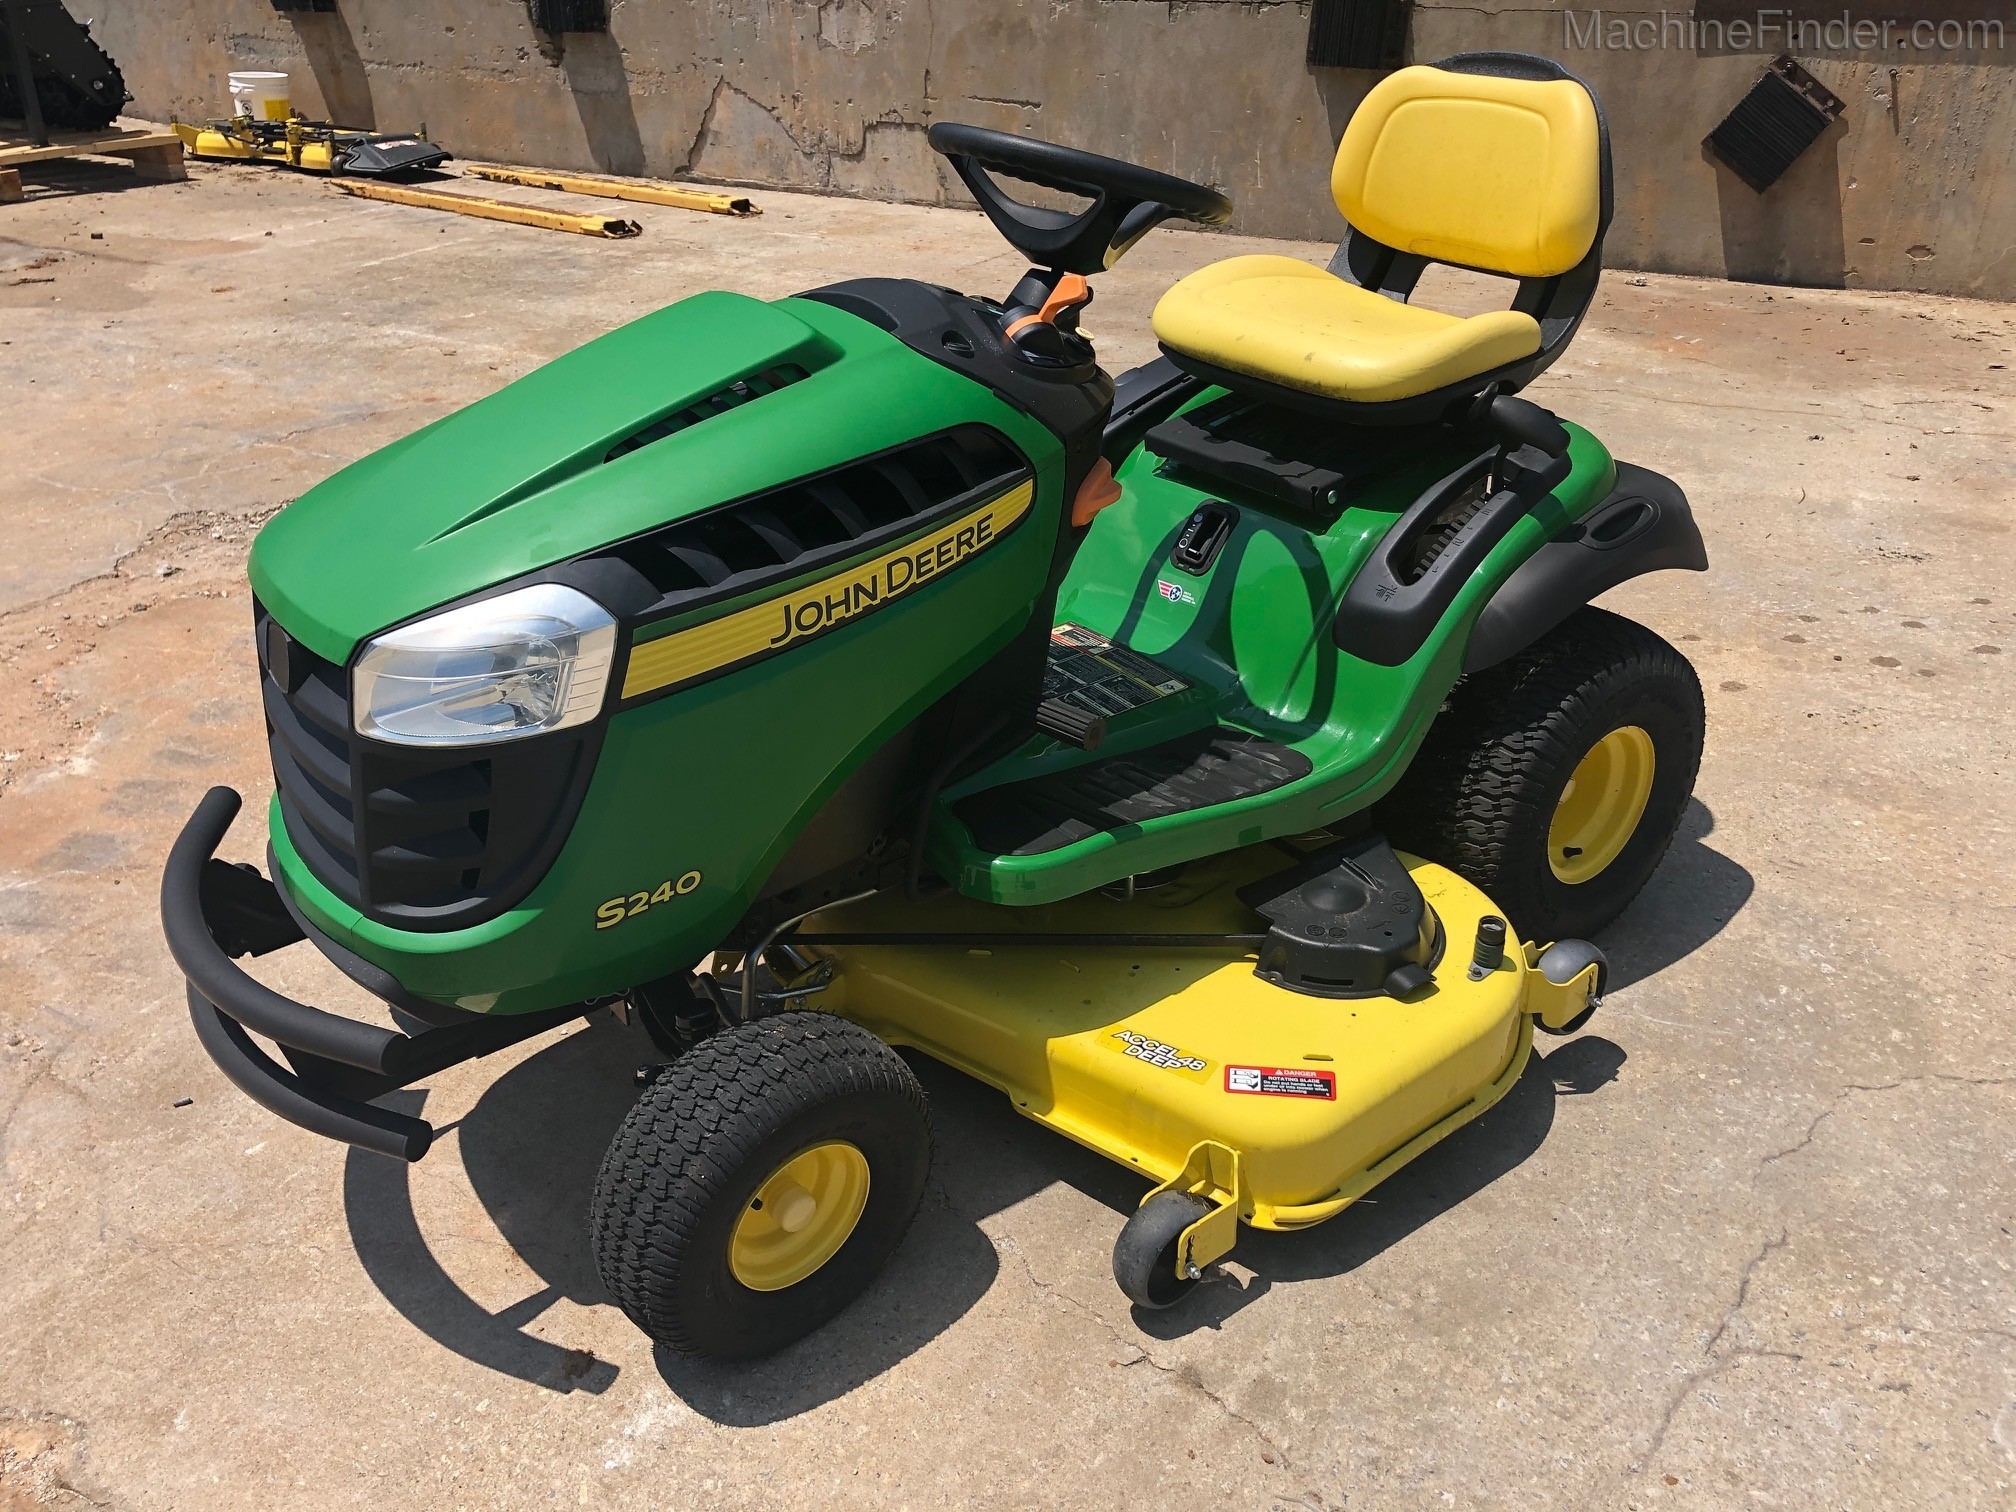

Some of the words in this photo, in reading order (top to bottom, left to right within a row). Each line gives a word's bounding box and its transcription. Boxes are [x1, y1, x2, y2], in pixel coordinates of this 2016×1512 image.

[769, 574, 878, 647] JOHN
[886, 512, 994, 596] DEERE
[596, 870, 702, 930] S240
[1112, 1029, 1180, 1061] ACCEL
[1177, 1056, 1207, 1071] 48
[1122, 1044, 1182, 1070] DEEP
